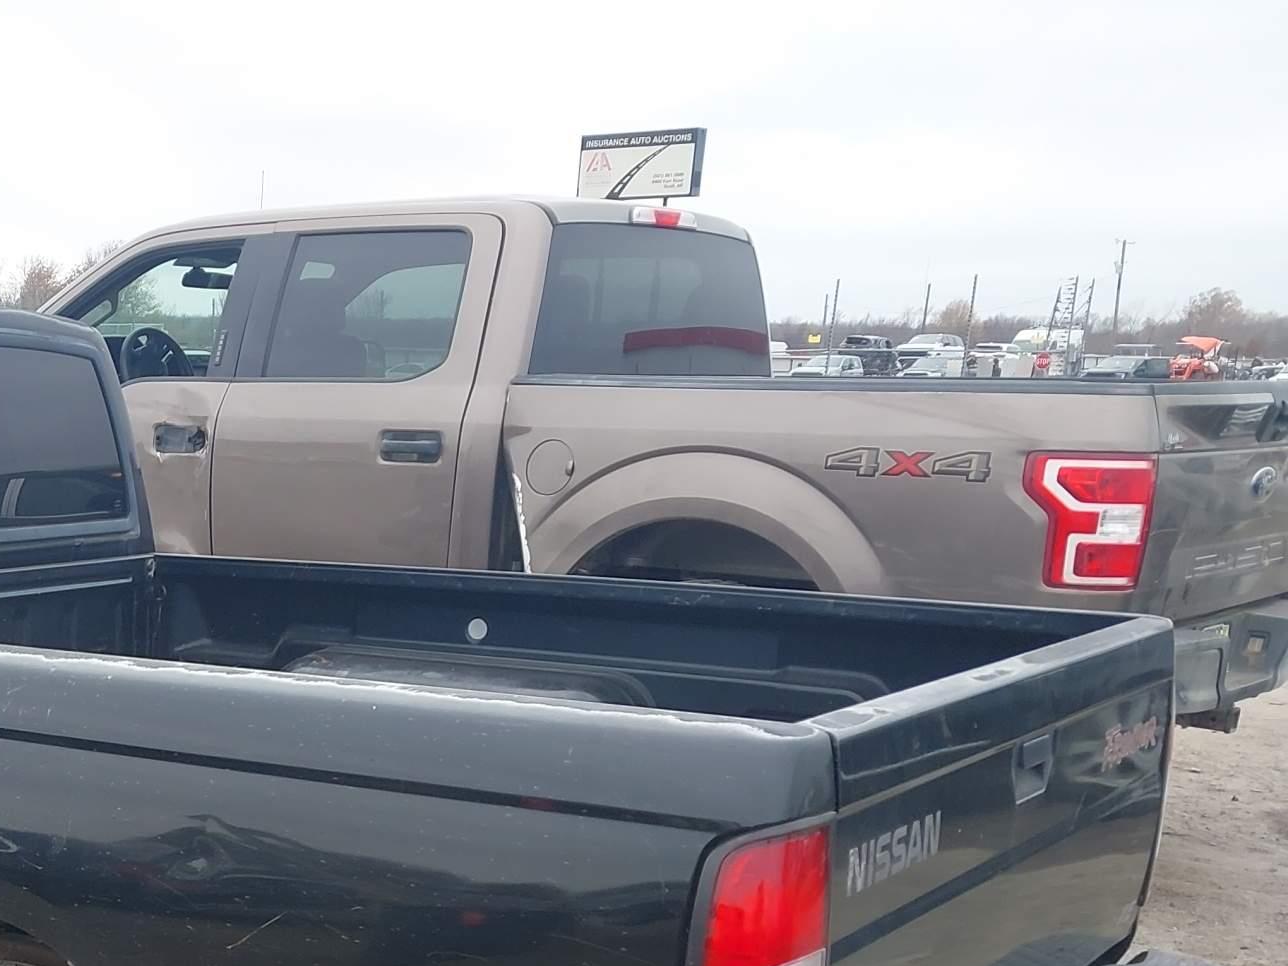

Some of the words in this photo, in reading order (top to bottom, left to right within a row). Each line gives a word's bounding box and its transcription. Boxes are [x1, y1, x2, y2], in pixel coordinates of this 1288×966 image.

[586, 138, 629, 148] INSURANCE
[630, 136, 651, 145] AUTO
[652, 133, 692, 143] AUCTIONS
[847, 810, 941, 897] NISSAN
